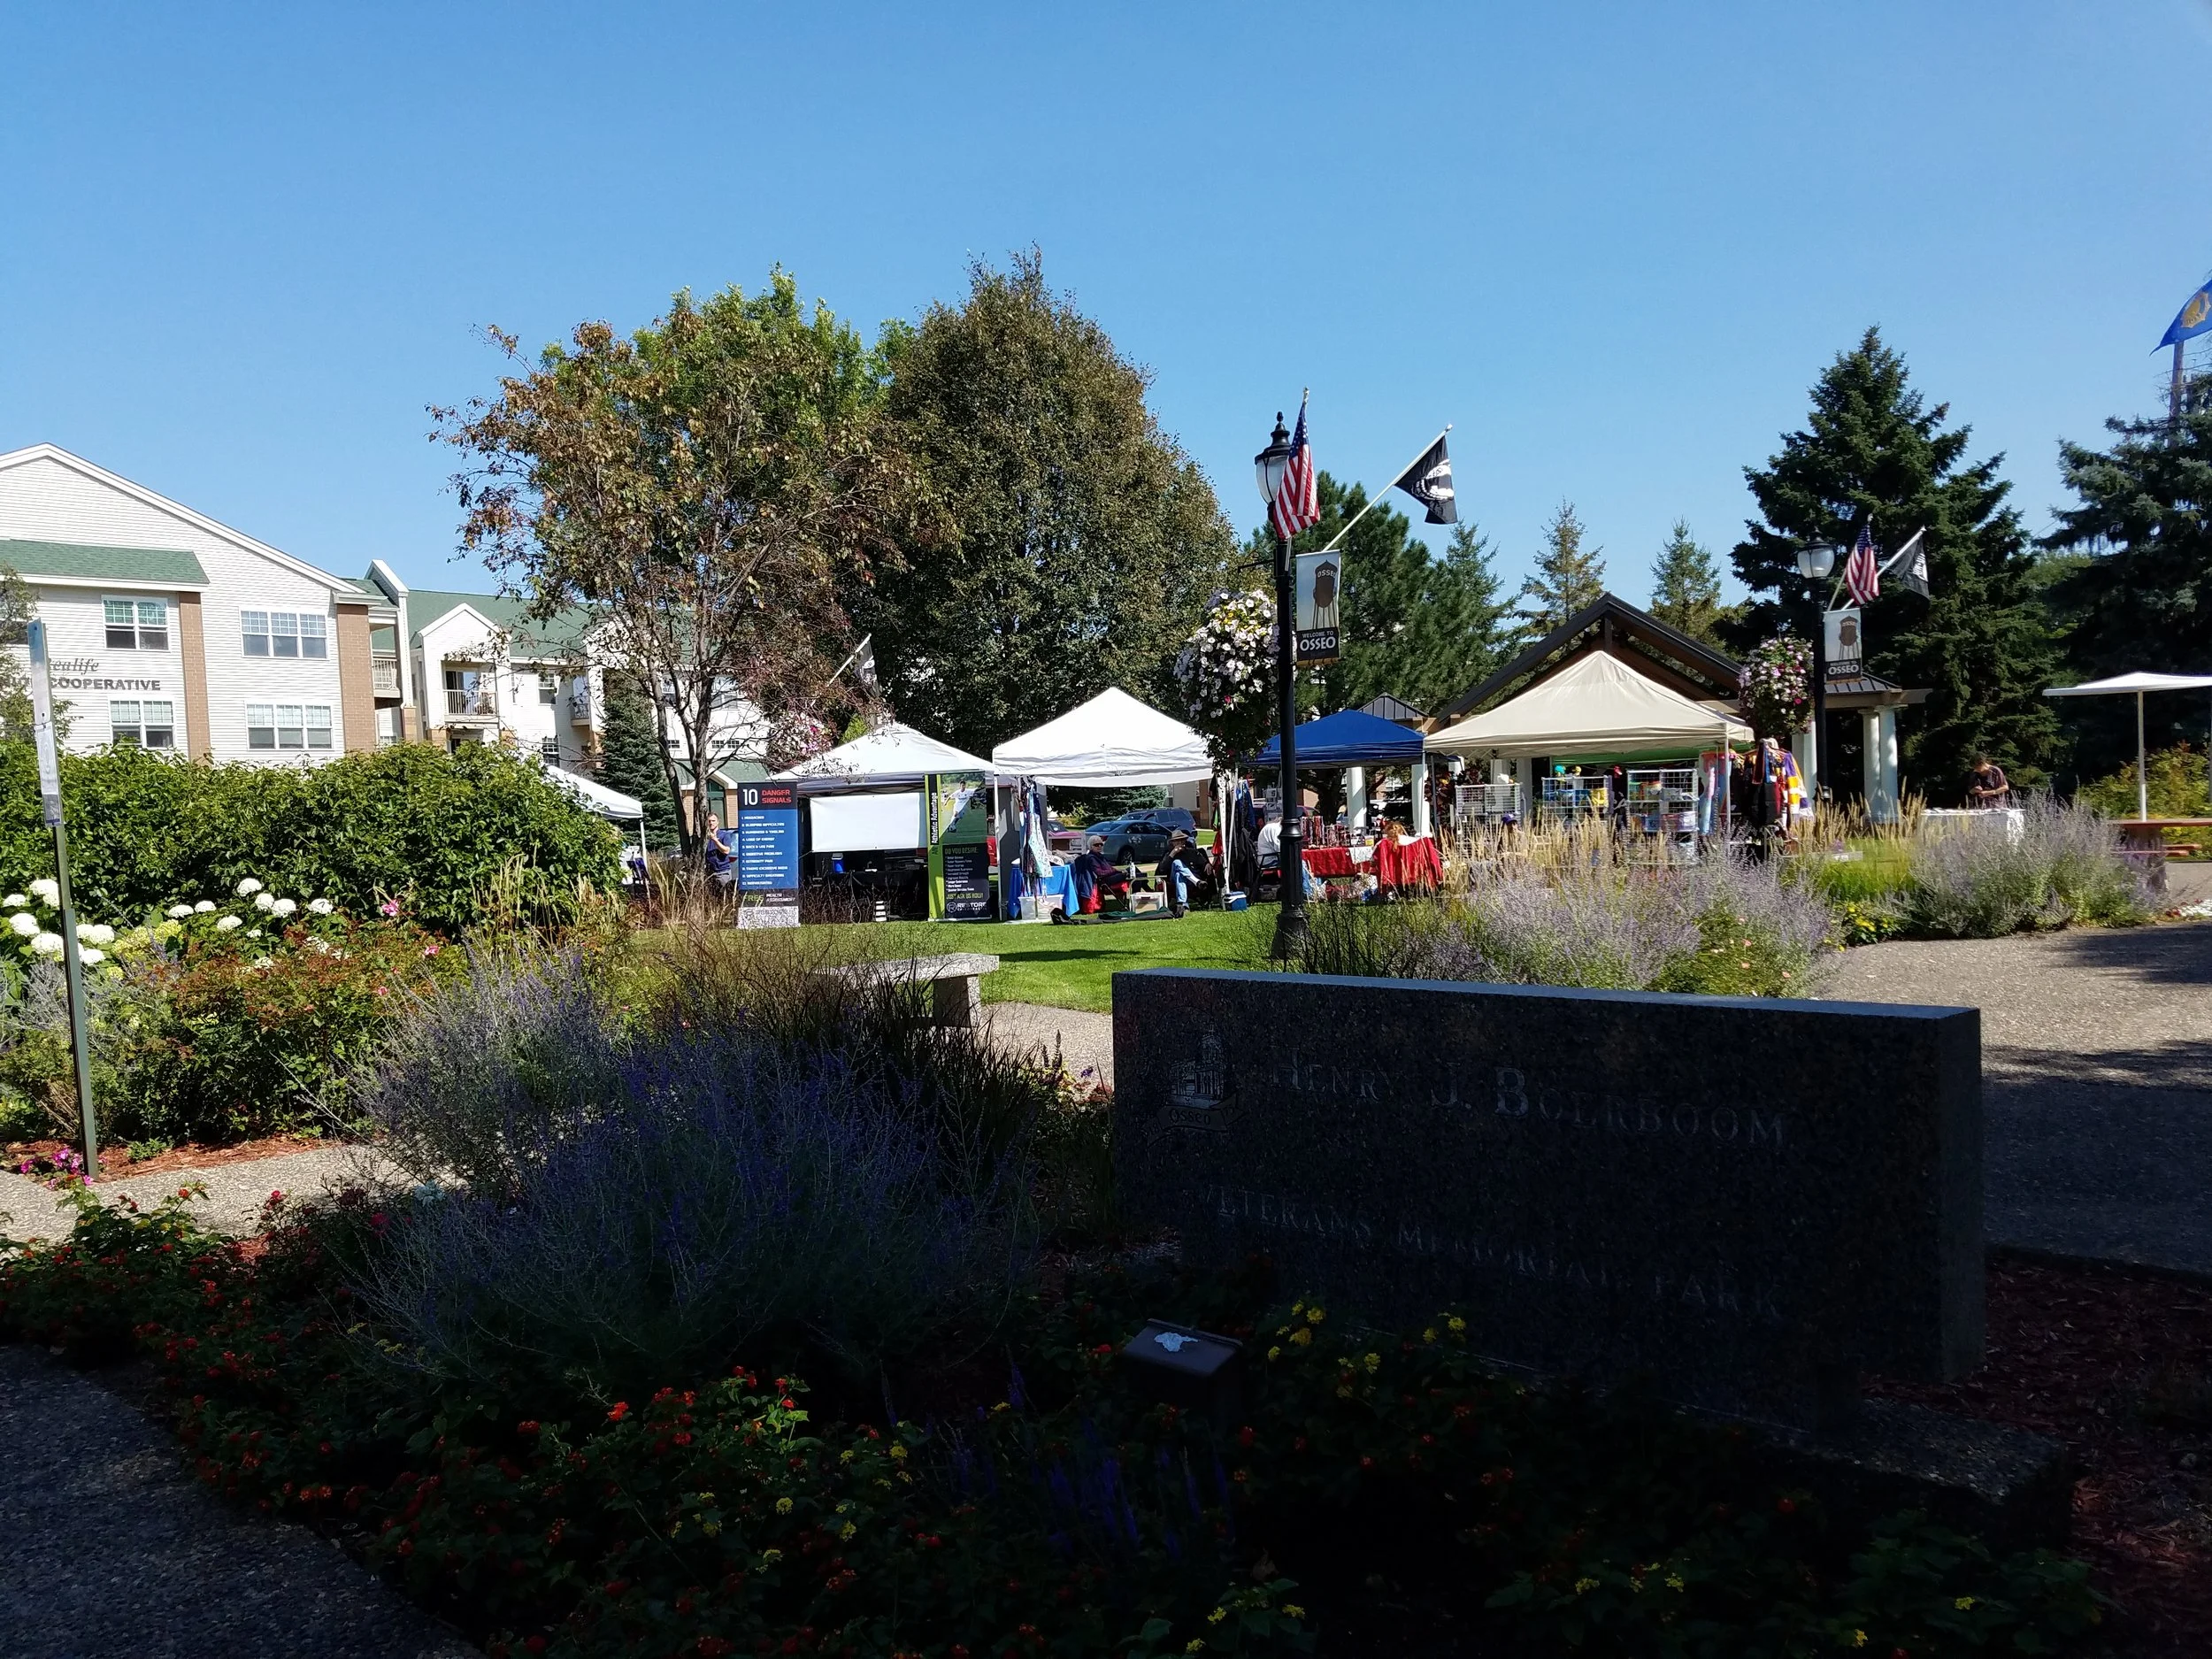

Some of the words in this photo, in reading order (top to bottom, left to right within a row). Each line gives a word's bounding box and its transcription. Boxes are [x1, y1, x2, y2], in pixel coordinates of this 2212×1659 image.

[1300, 636, 1336, 651] OSSEO
[49, 657, 99, 675] ealife
[1828, 664, 1859, 675] OSSEO
[50, 677, 161, 691] COOPERATIVE
[742, 788, 758, 805] 10
